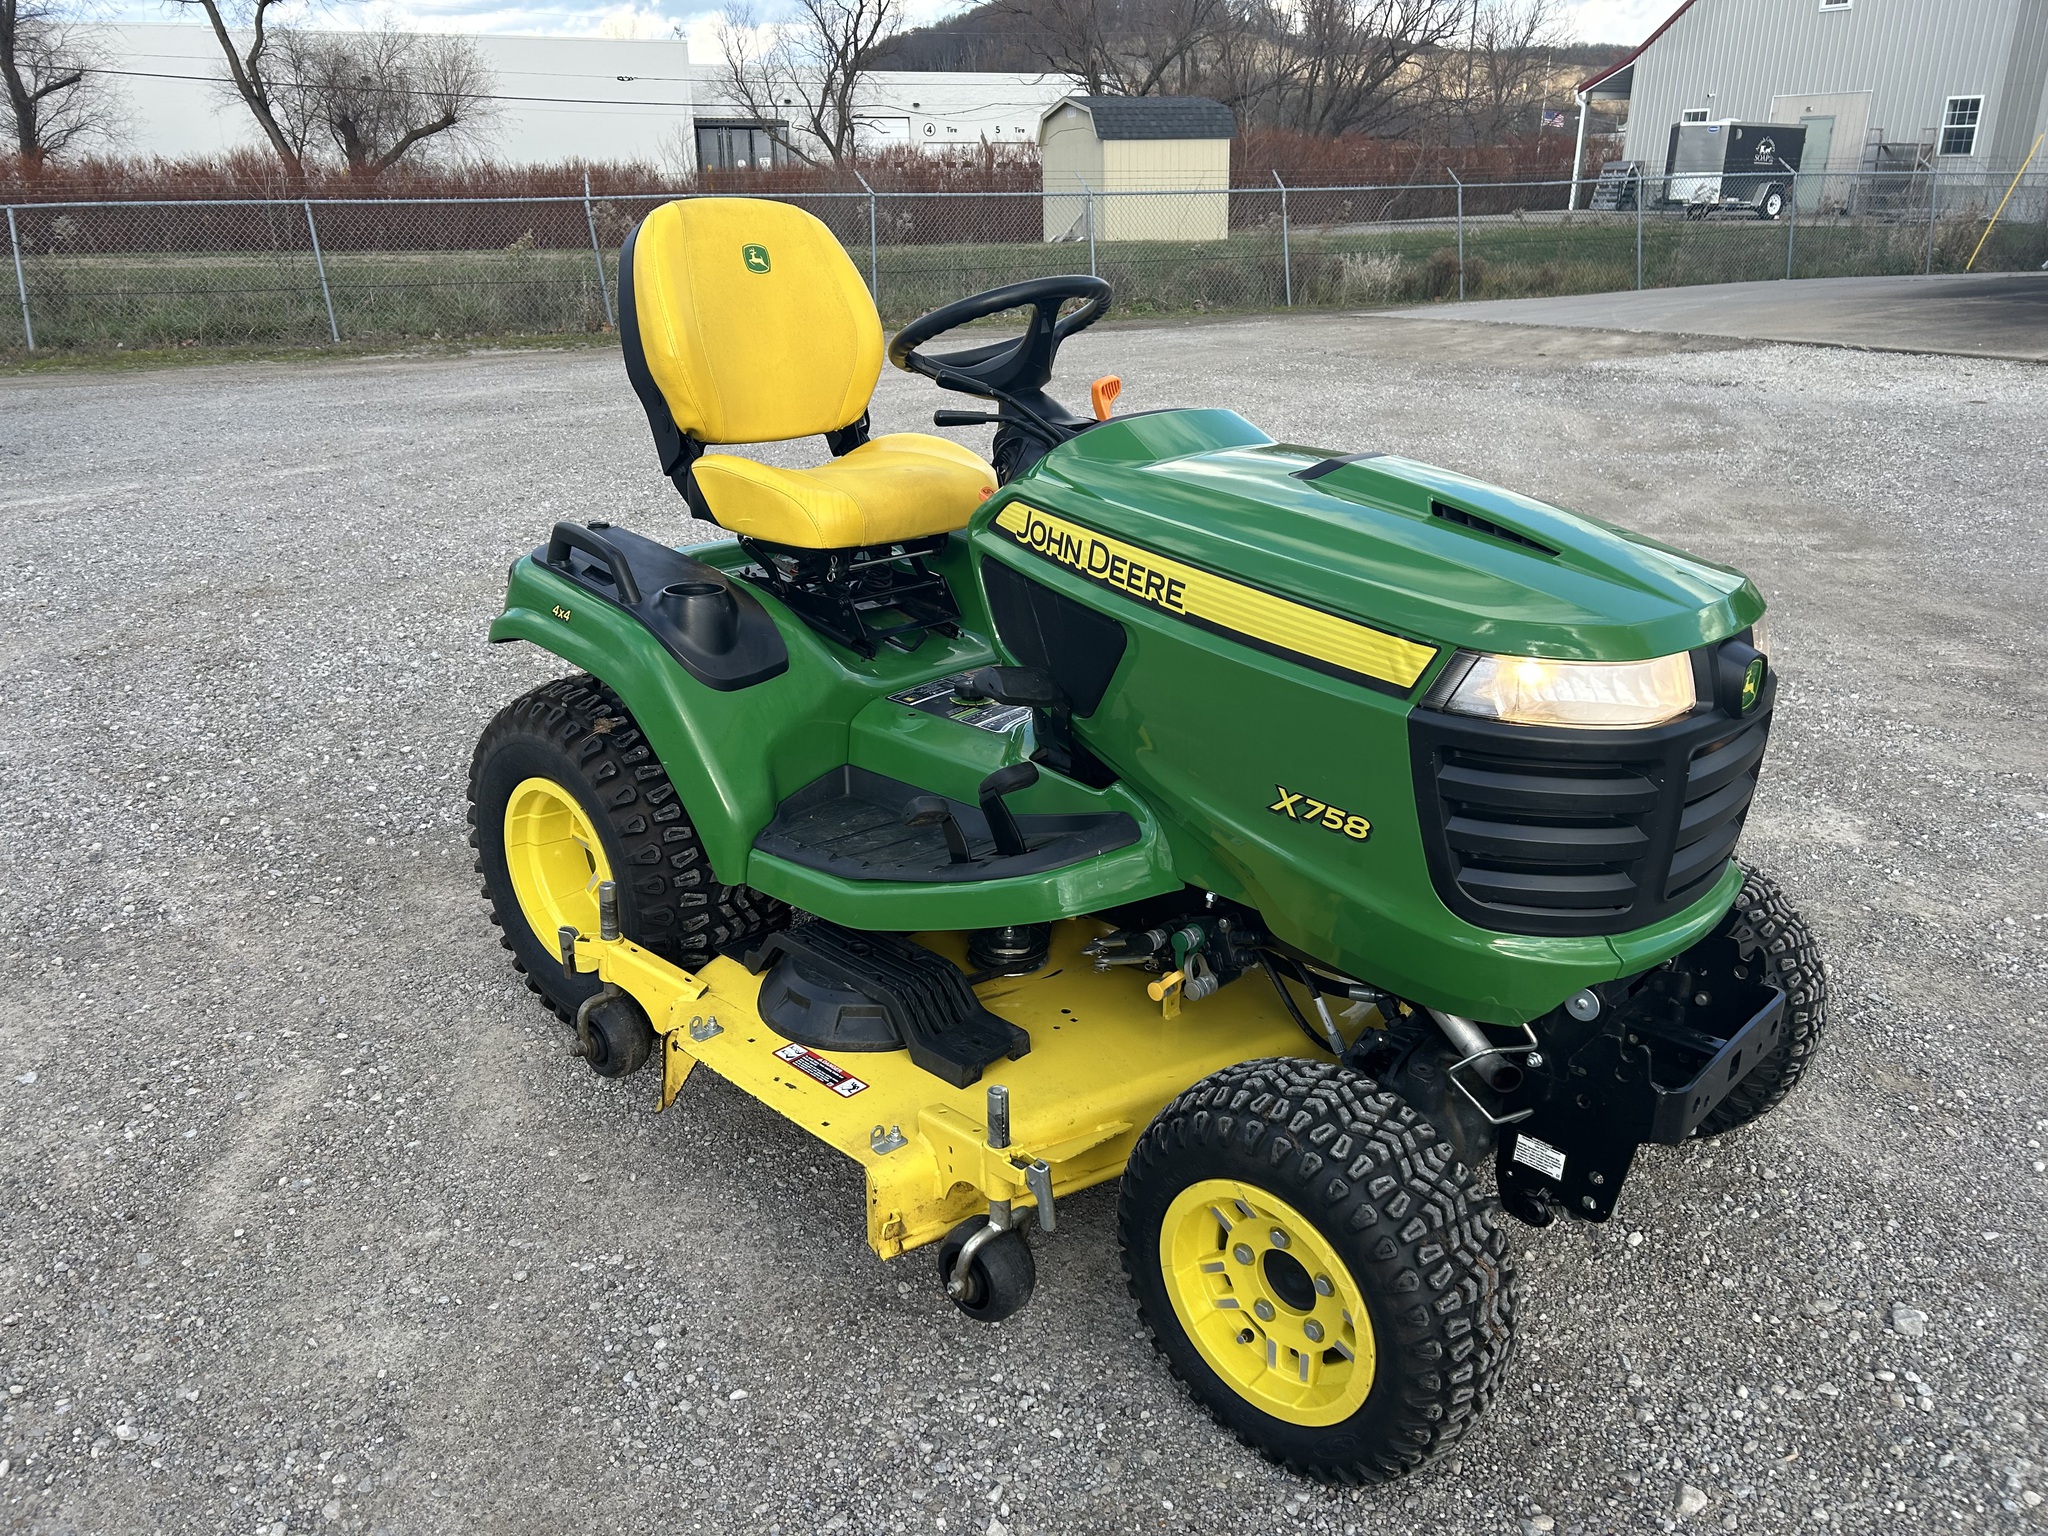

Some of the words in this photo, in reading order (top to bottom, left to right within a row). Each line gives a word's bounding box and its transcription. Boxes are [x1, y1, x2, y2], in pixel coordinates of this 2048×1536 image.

[995, 125, 1001, 134] 5
[1016, 510, 1083, 567] JOHN
[1087, 538, 1187, 612] DEERE
[552, 604, 572, 622] 4x4
[1266, 784, 1373, 842] X758
